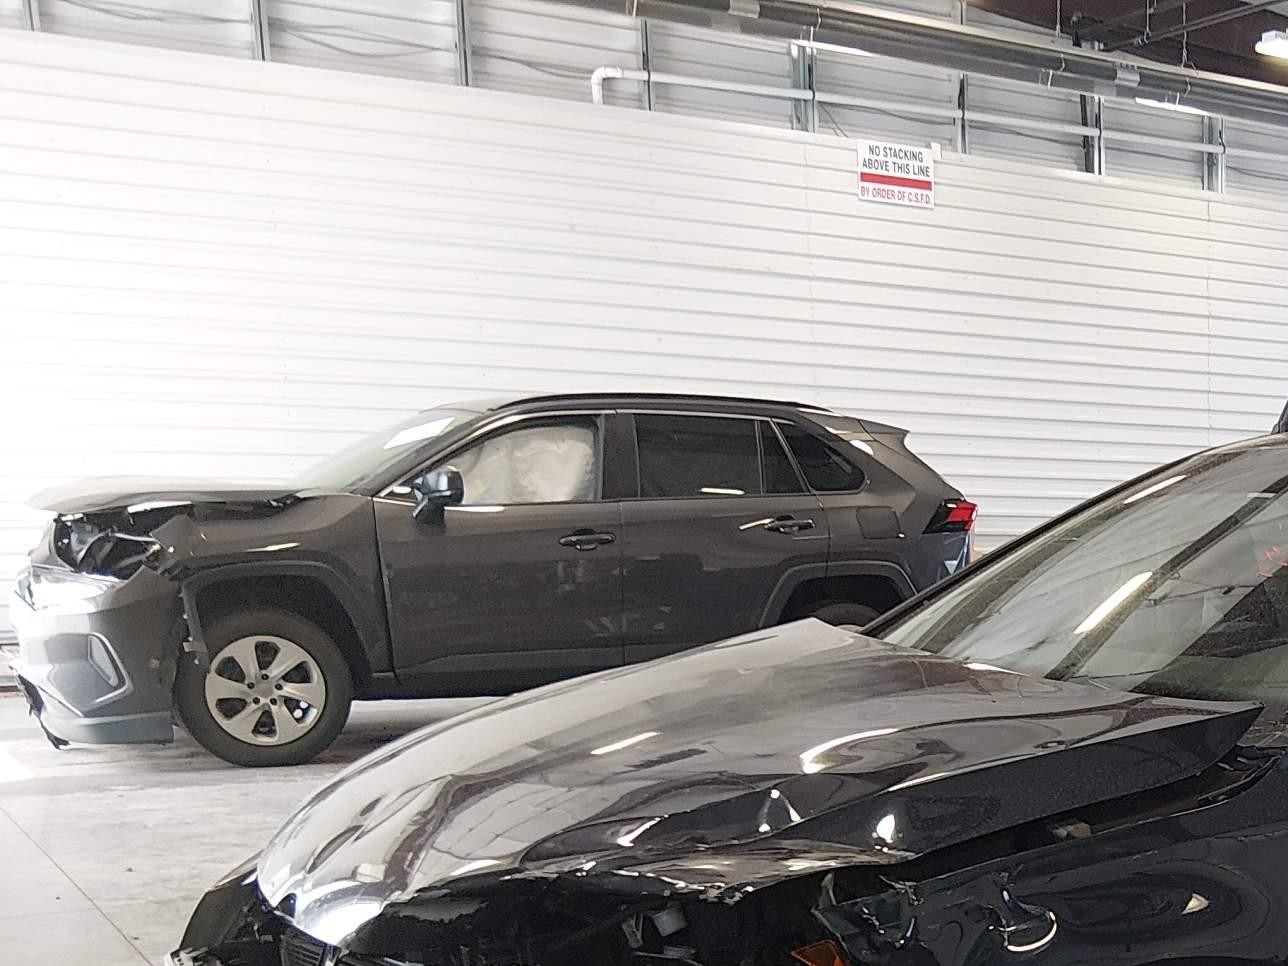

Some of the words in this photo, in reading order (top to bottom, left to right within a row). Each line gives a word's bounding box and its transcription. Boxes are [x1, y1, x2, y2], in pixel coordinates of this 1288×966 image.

[868, 145, 881, 156] NO
[883, 147, 923, 162] STACKING
[862, 158, 889, 172] ABOVE
[892, 161, 910, 175] THIS
[913, 164, 930, 177] LINE
[861, 186, 870, 197] BY
[872, 187, 896, 201] ORDER
[897, 191, 906, 201] OF
